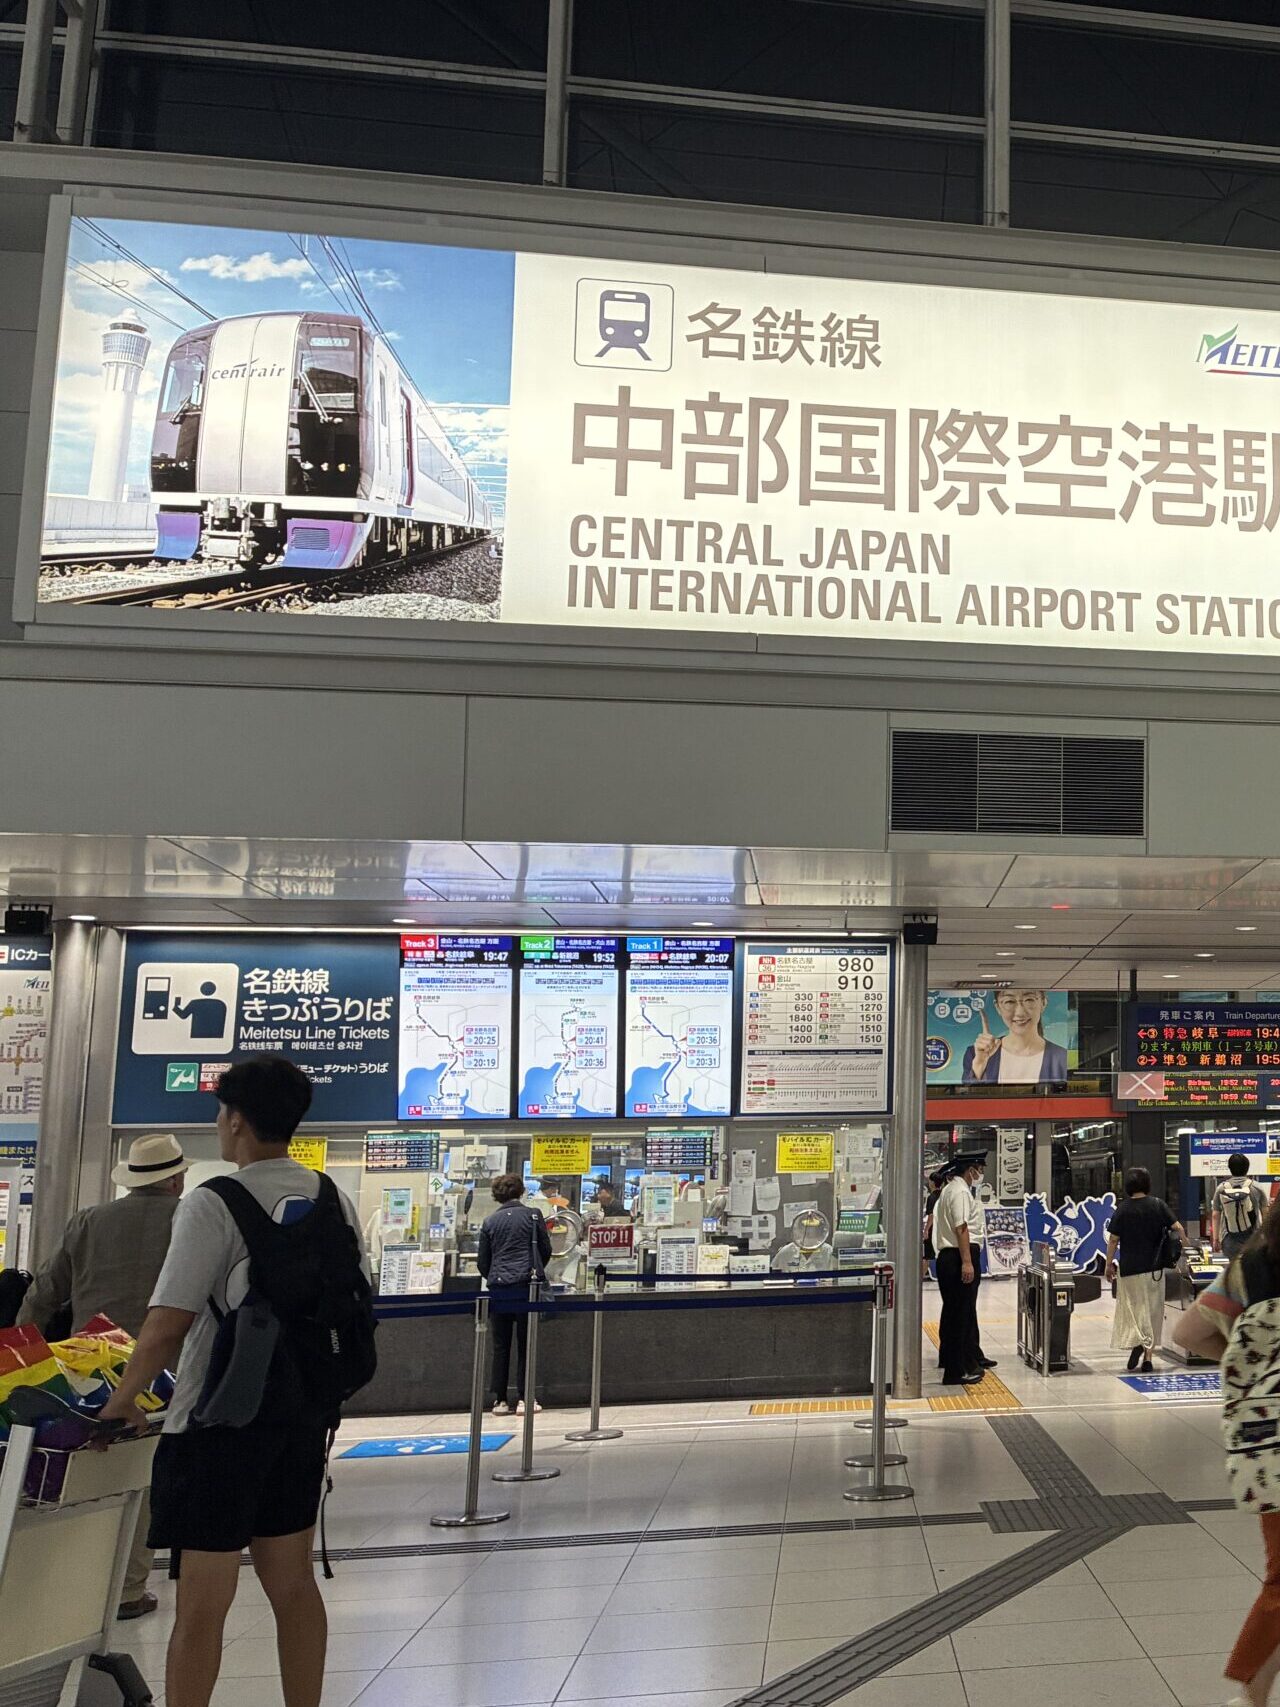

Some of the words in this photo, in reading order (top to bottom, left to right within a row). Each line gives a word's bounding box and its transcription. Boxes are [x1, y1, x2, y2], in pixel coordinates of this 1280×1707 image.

[686, 301, 882, 370] 名鉄線
[211, 359, 286, 381] centrair
[570, 514, 784, 567] CENTRAL
[800, 527, 951, 575] JAPAN
[567, 564, 942, 624] INTERNATIONAL
[955, 584, 1142, 632] AIRPORT
[427, 938, 434, 947] 3
[544, 940, 551, 949] 2
[653, 941, 658, 949] 1
[483, 952, 509, 961] 19:47
[593, 953, 615, 962] 19:52
[704, 954, 729, 963] 20:07
[838, 957, 874, 972] 980
[243, 968, 329, 994] 名鉄線
[838, 975, 873, 990] 910
[794, 993, 813, 1001] 330
[242, 995, 394, 1022] きっぷうりば
[794, 1003, 813, 1011] 650
[860, 1003, 882, 1011] 1270
[789, 1014, 813, 1022] 1840
[860, 1014, 882, 1022] 1510
[1159, 1011, 1215, 1021] 発車ご案内
[1224, 1012, 1244, 1020] Train
[239, 1025, 301, 1040] Meitetsu
[304, 1025, 338, 1040] Line
[340, 1025, 390, 1040] Tickets
[789, 1025, 812, 1033] 1400
[860, 1024, 882, 1032] 1510
[1163, 1028, 1188, 1039] 特急
[1192, 1028, 1218, 1039] 岐阜
[474, 1036, 496, 1045] 20:25
[584, 1036, 604, 1044] 20:41
[696, 1036, 717, 1044] 20:36
[859, 1035, 882, 1043] 1510
[474, 1059, 496, 1067] 20:19
[584, 1058, 604, 1067] 20:36
[696, 1058, 717, 1066] 20:31
[1163, 1054, 1188, 1066] 準急
[591, 1231, 616, 1244] STOP
